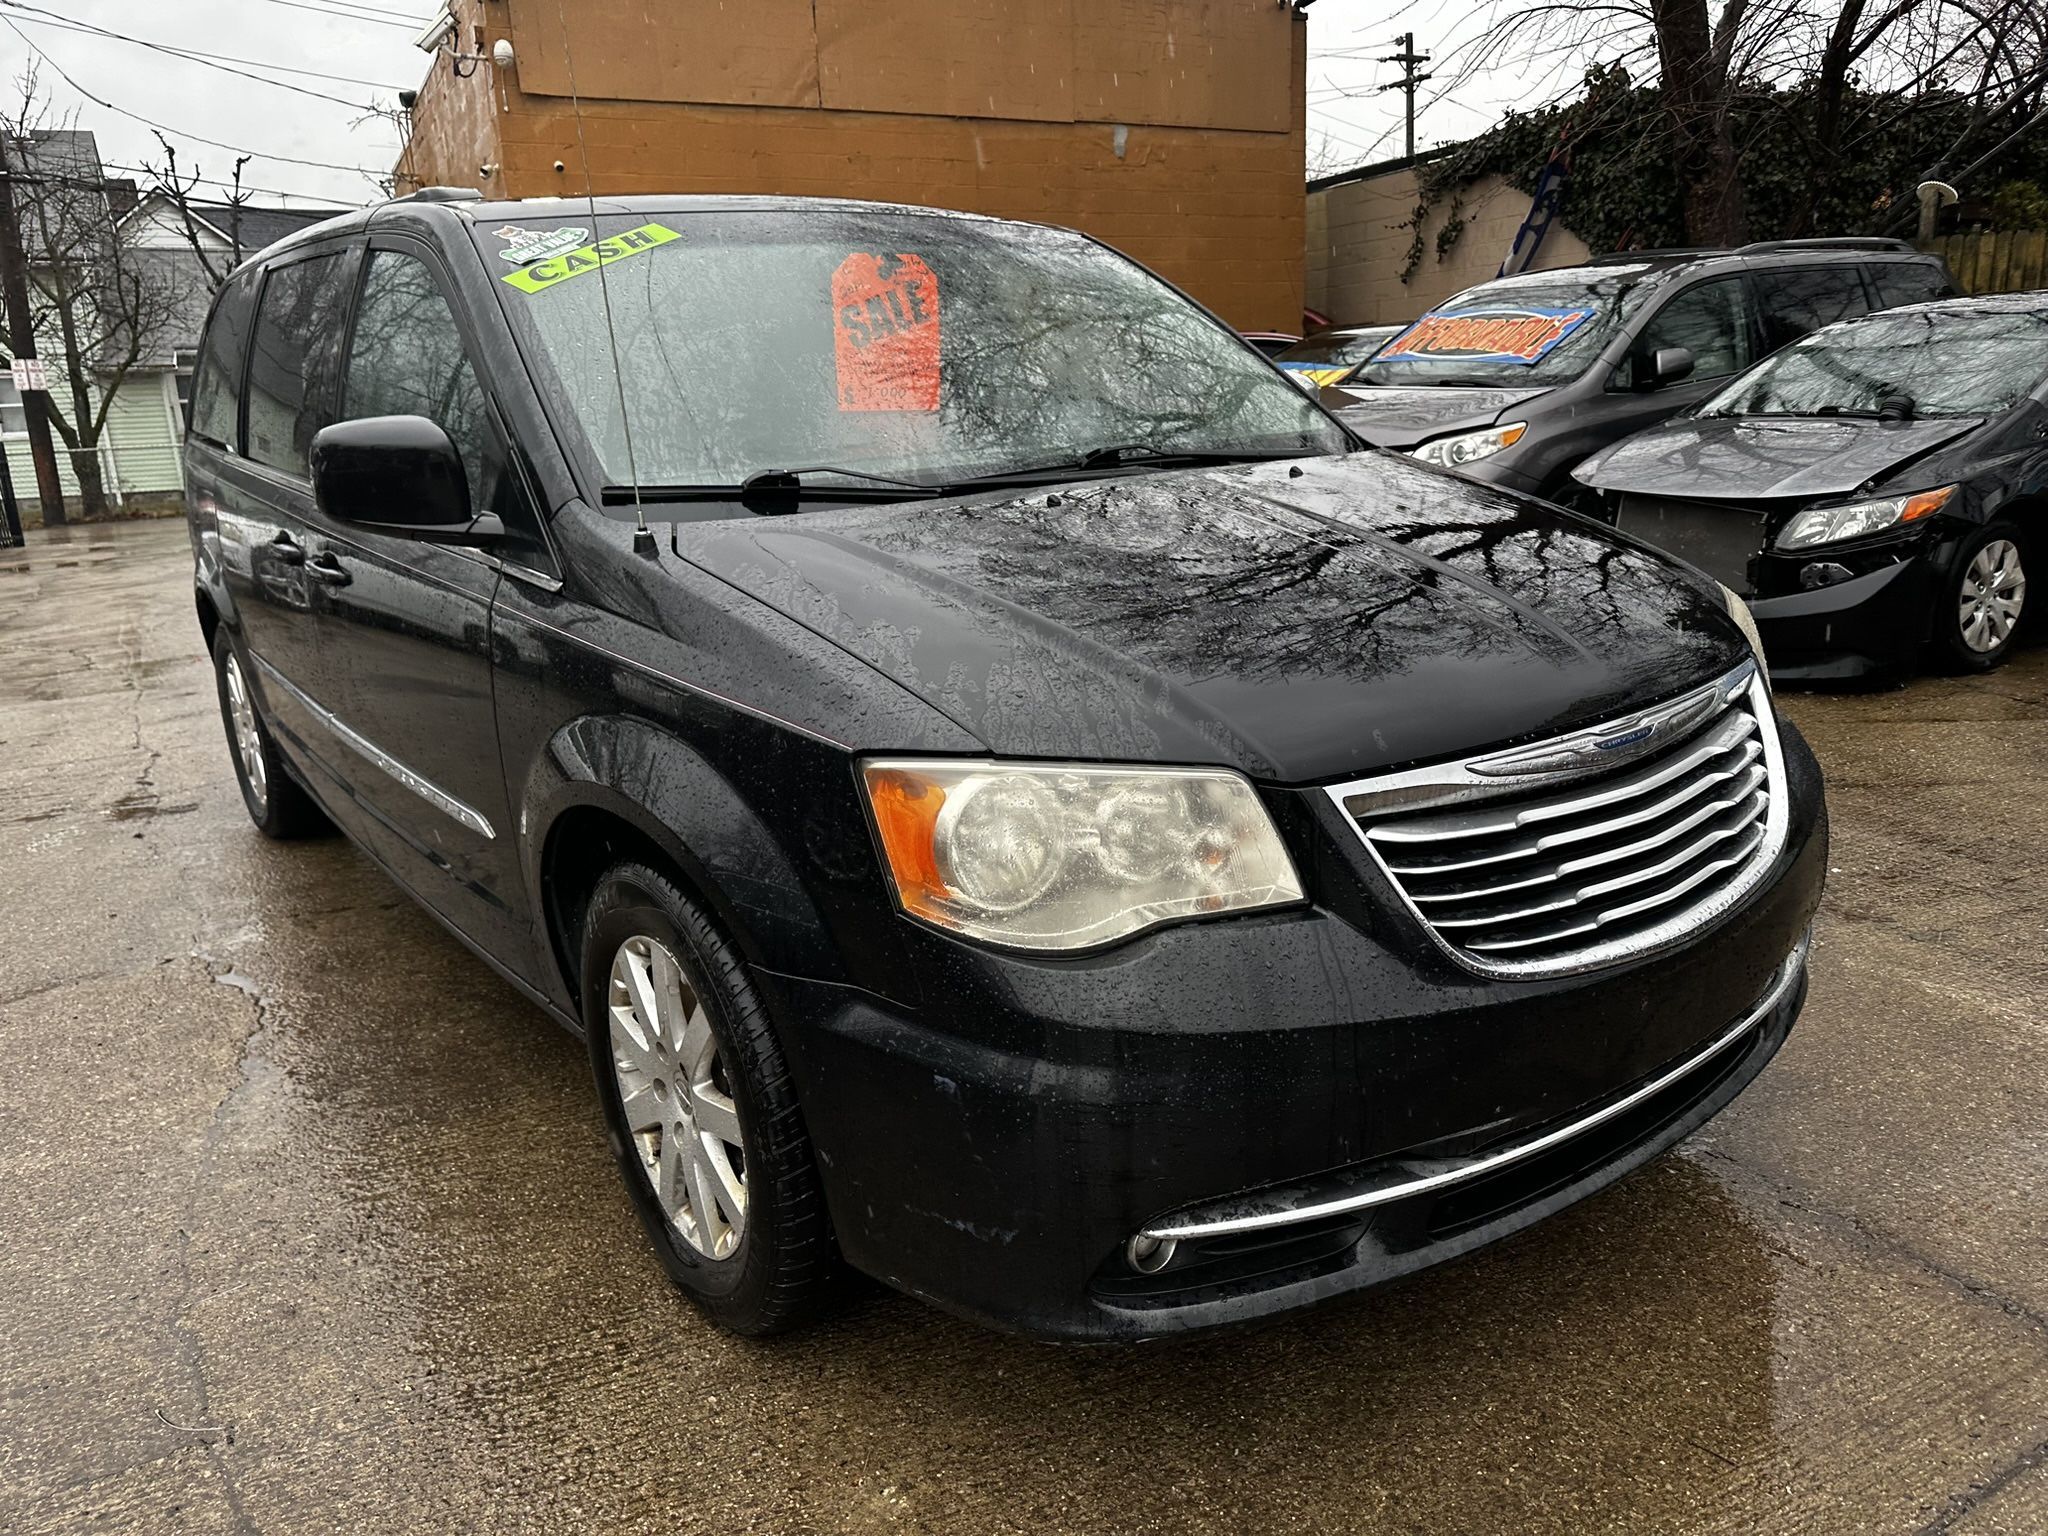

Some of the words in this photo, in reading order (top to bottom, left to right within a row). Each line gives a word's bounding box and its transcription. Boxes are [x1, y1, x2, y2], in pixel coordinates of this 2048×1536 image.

[511, 243, 549, 261] GREAT
[528, 230, 656, 282] CASH
[840, 281, 931, 349] SALE
[1378, 312, 1585, 360] AFFORDABLE
[1601, 729, 1649, 748] CHRYSLER
